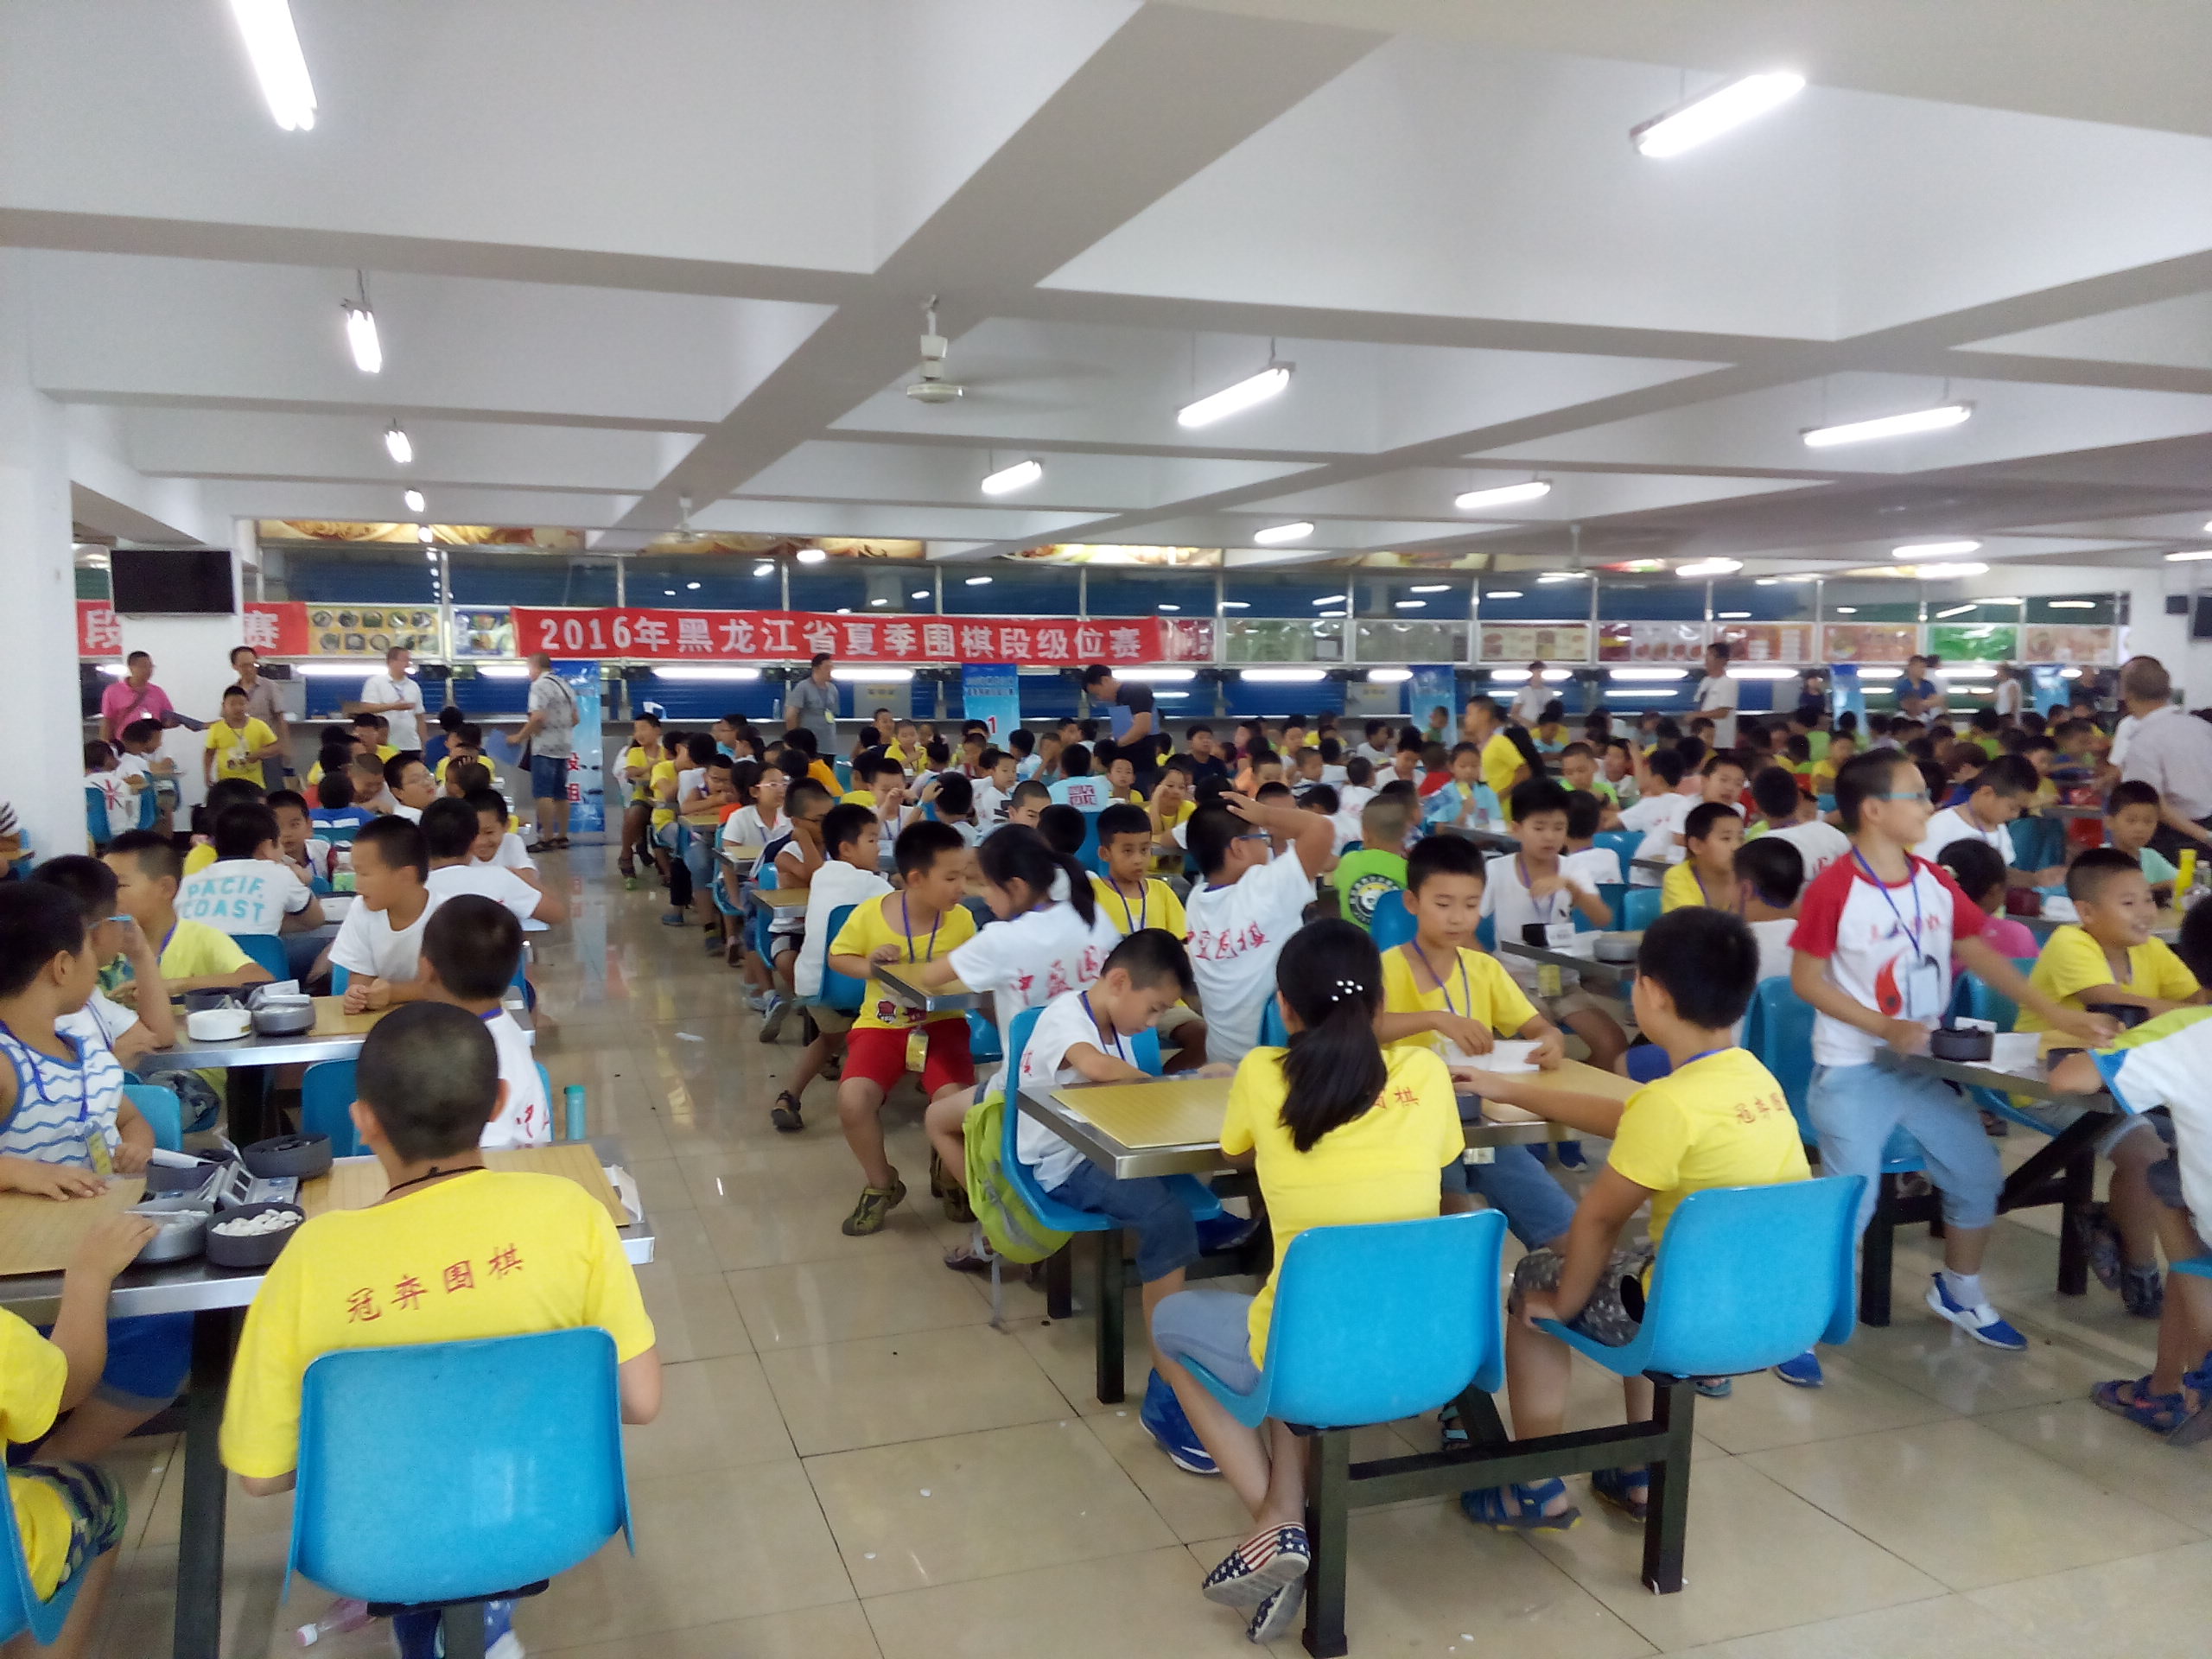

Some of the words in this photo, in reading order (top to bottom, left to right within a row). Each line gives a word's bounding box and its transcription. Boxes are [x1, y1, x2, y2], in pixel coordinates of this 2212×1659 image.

[539, 615, 1141, 660] 2016年黑龙江省夏季围棋段级位赛
[180, 899, 265, 923] COAST
